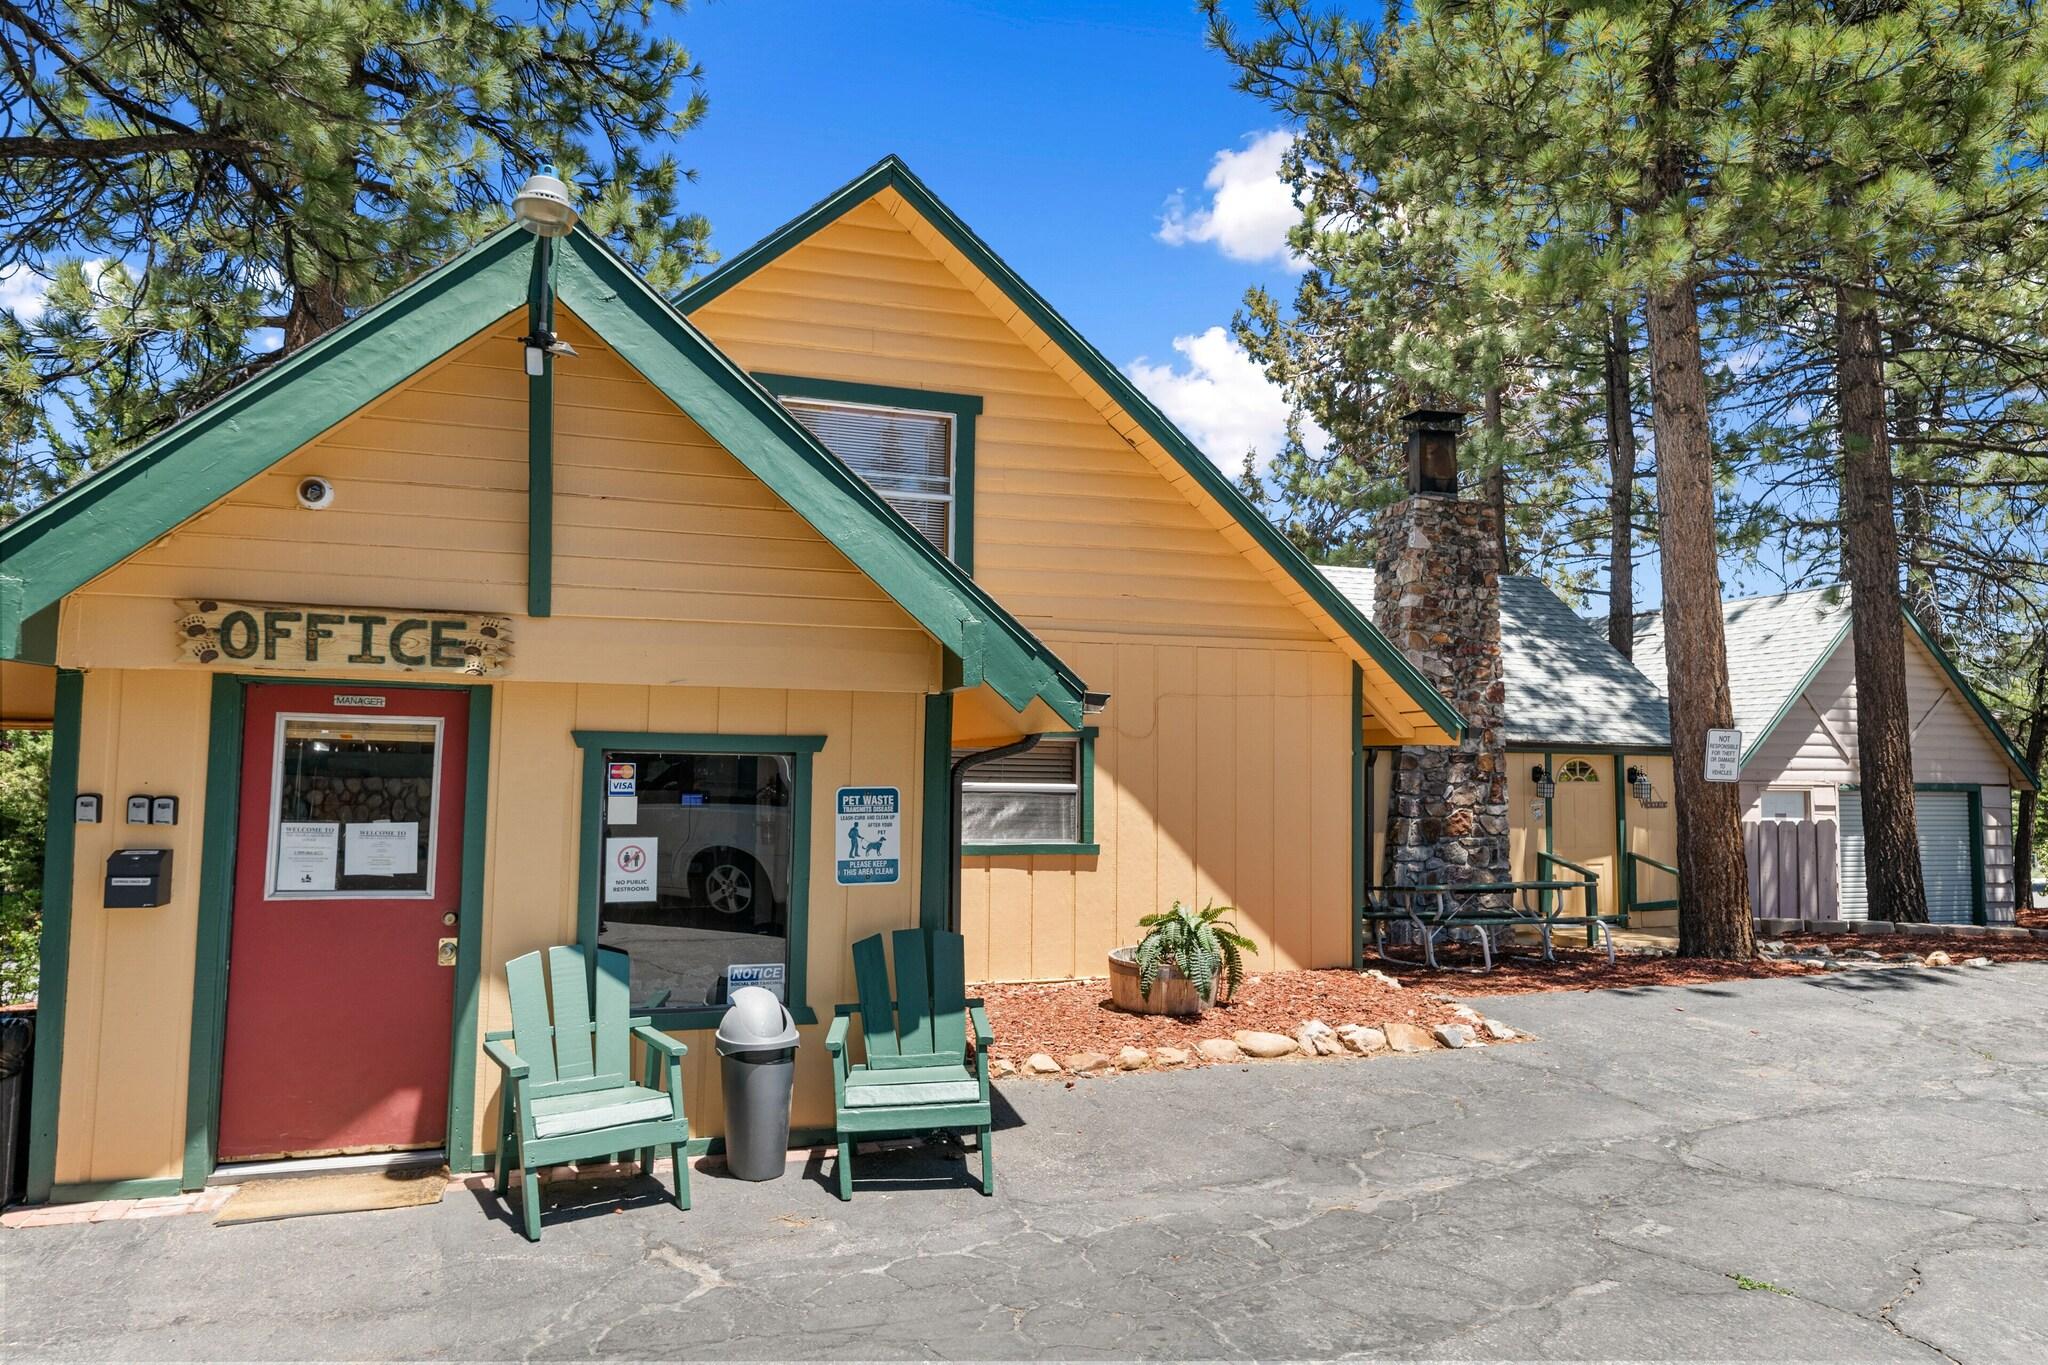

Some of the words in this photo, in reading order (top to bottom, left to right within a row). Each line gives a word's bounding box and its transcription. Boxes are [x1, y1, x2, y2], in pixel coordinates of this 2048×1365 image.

[219, 609, 468, 668] OFFICE
[336, 696, 384, 706] MANAGER
[613, 782, 633, 790] VISA
[842, 795, 859, 805] PET
[863, 794, 894, 805] WASTE
[843, 805, 872, 813] TRANSMITS
[872, 805, 894, 813] DISEASE
[849, 860, 872, 868] PLEASE
[858, 868, 874, 876] AREA
[875, 867, 894, 875] CLEAN
[732, 967, 782, 980] NOTICE
